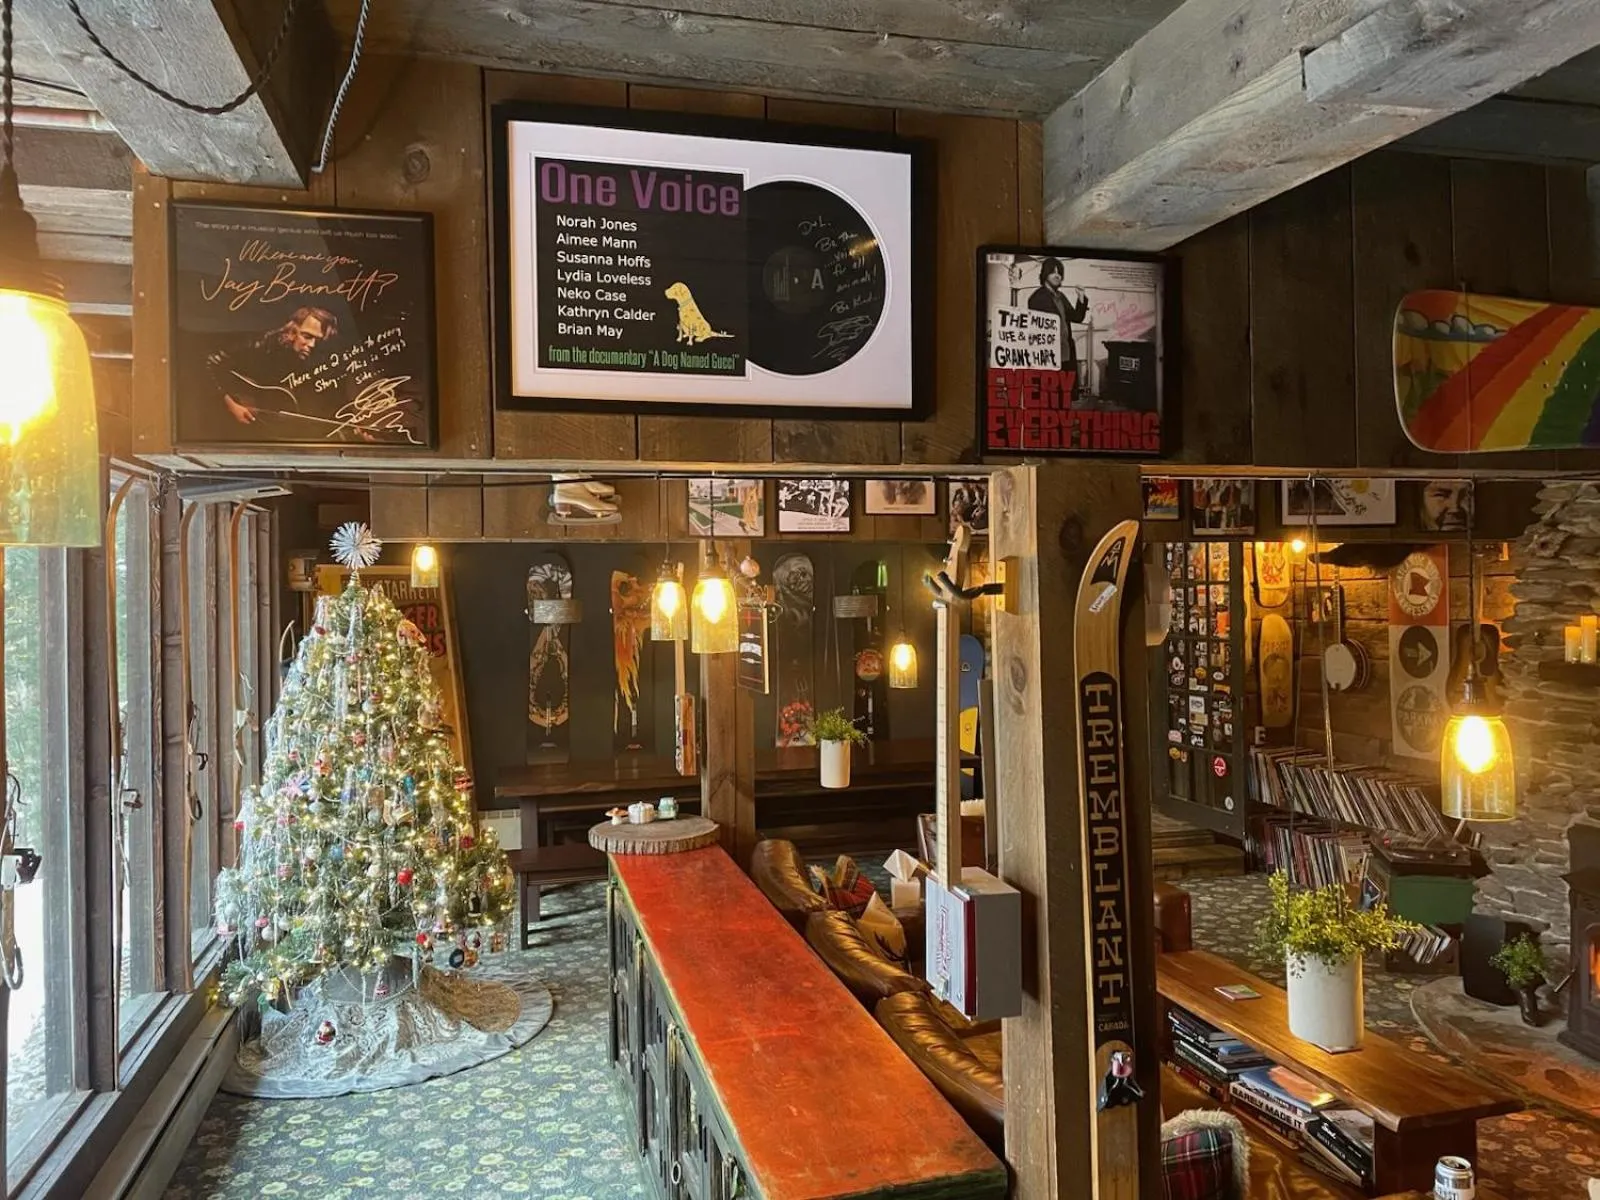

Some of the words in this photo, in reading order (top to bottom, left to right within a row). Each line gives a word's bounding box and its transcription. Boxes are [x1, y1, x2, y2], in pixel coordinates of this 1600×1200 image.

[541, 162, 617, 207] One
[630, 169, 740, 217] Voice
[556, 214, 596, 229] Norah
[600, 217, 638, 232] Jones
[239, 239, 298, 262] Where
[299, 252, 325, 261] are
[556, 232, 598, 247] Aimee
[602, 236, 638, 250] Mann
[556, 251, 613, 266] Susanna
[617, 254, 652, 269] Hoffs
[201, 258, 265, 312] Jay
[260, 262, 399, 311] Bennett?
[557, 269, 592, 284] Lydia
[596, 272, 652, 286] Loveless
[810, 267, 825, 290] A
[557, 287, 591, 300] Neko
[595, 289, 627, 302] Case
[557, 305, 610, 320] Kathryn
[613, 307, 656, 321] Calder
[998, 309, 1028, 329] THE
[557, 322, 592, 336] Brian
[596, 325, 624, 340] May
[549, 345, 571, 362] from
[572, 347, 587, 363] the
[588, 347, 647, 369] documentary
[661, 351, 678, 370] Dog
[680, 352, 709, 368] Named
[280, 372, 312, 389] There
[987, 370, 1076, 410] EVERY
[986, 408, 1161, 450] EVERYTHING
[1254, 726, 1267, 745] E
[1085, 683, 1124, 1005] TREMBLANT
[1231, 1086, 1264, 1109] BARELY
[1264, 1102, 1293, 1123] MADE
[1293, 1117, 1303, 1130] IT
